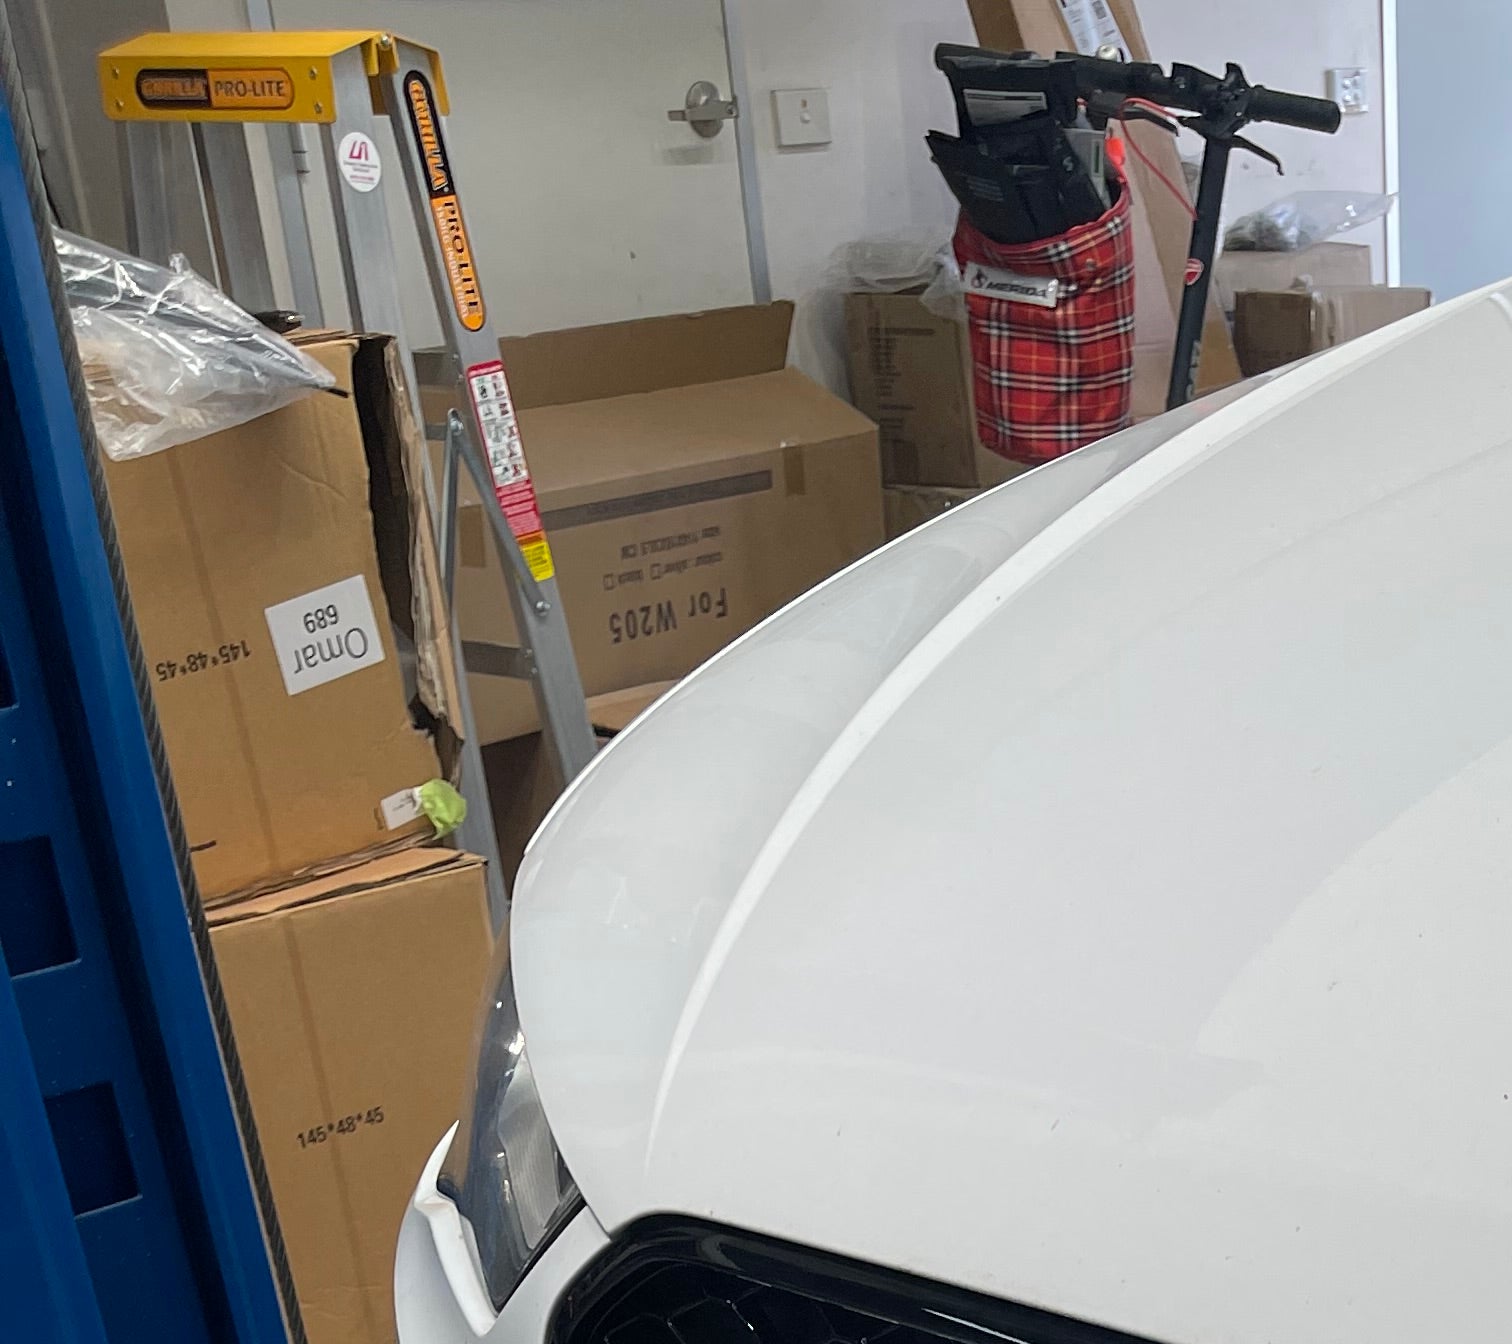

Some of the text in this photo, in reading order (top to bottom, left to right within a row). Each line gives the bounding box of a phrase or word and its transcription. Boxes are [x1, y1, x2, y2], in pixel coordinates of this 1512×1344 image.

[214, 80, 286, 98] PRO-LITE
[303, 603, 339, 634] 689
[609, 587, 728, 643] For W205
[293, 626, 369, 675] Omar
